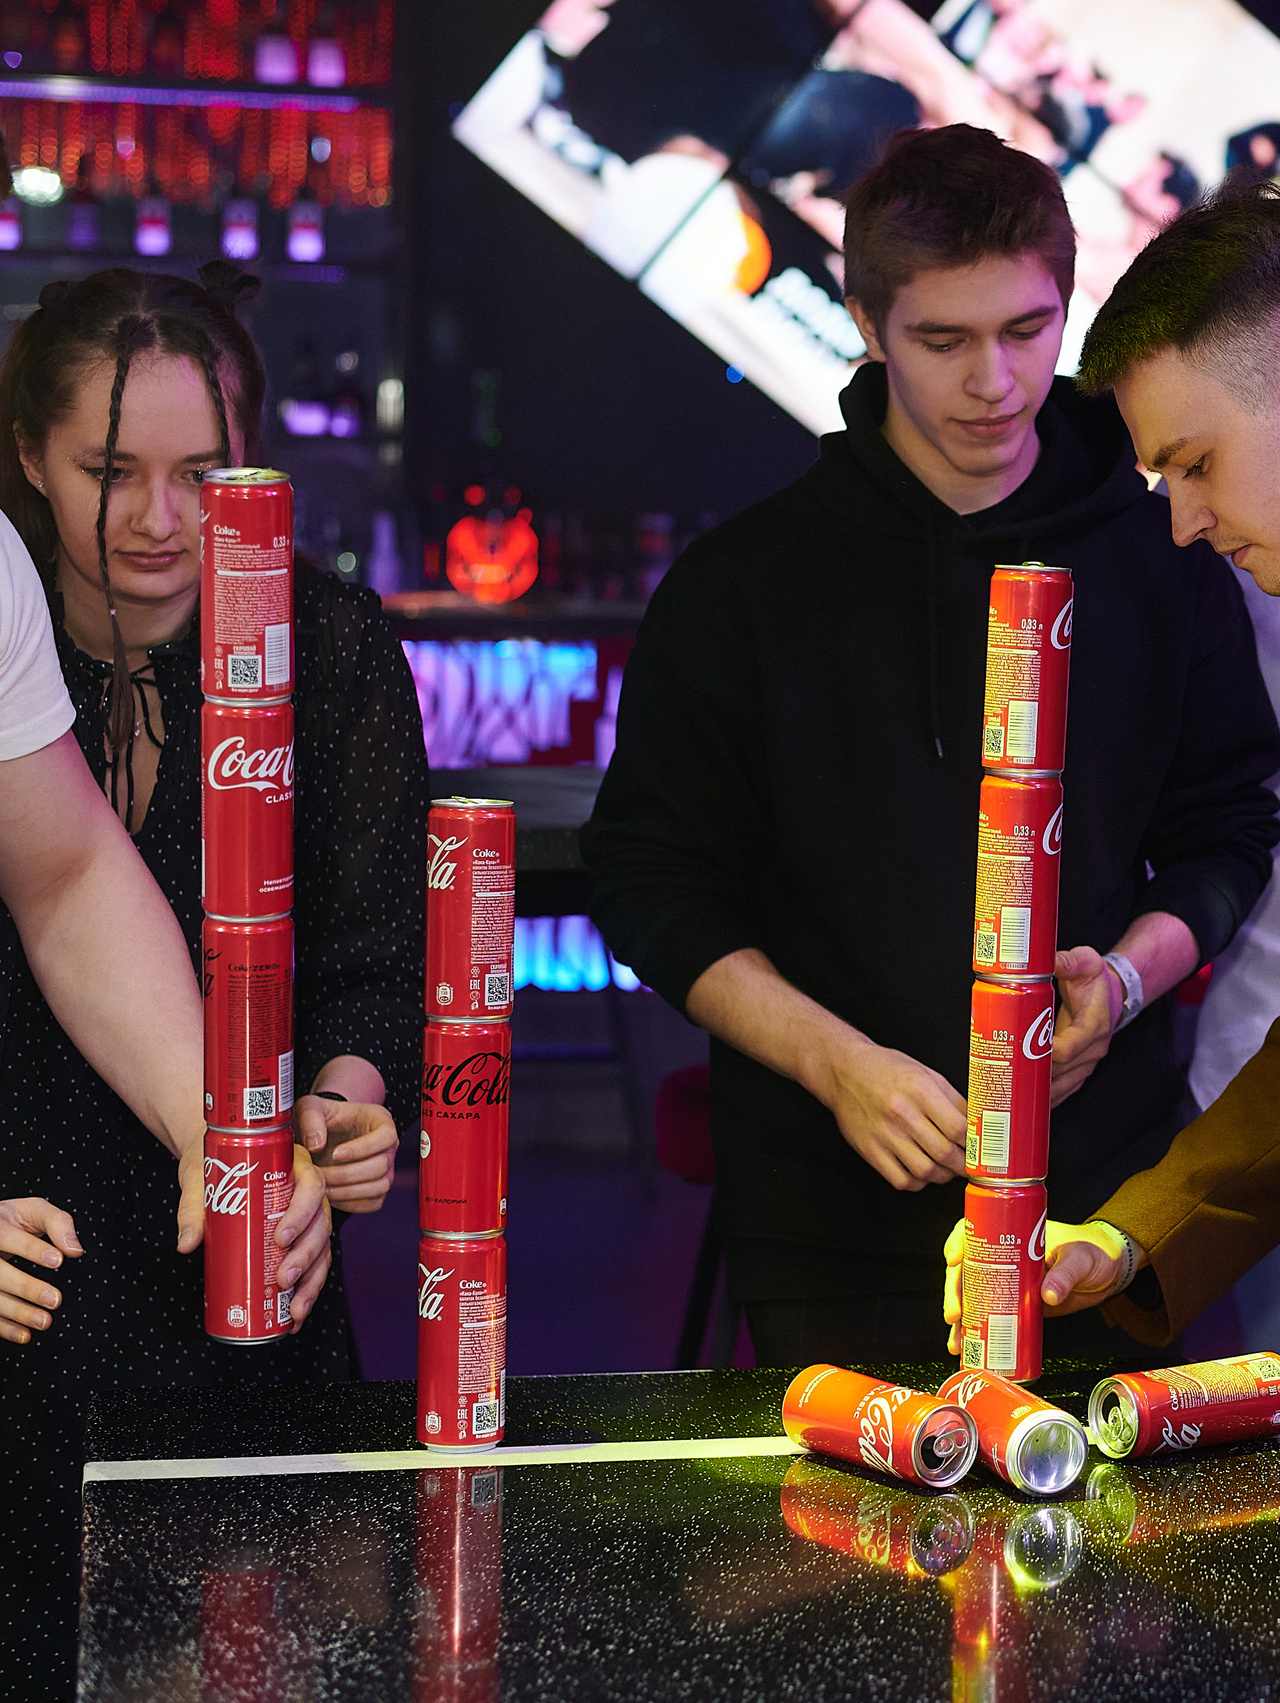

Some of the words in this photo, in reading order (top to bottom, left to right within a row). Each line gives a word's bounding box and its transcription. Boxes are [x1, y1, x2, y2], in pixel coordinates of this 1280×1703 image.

[213, 524, 236, 536] Coke
[1013, 825, 1029, 837] 0,33
[472, 848, 496, 858] Coke
[992, 1029, 1008, 1042] 0,33
[436, 1111, 480, 1120] САХАРА
[263, 1170, 284, 1182] Coke
[999, 1234, 1015, 1246] 0,33
[459, 1279, 483, 1289] Coke
